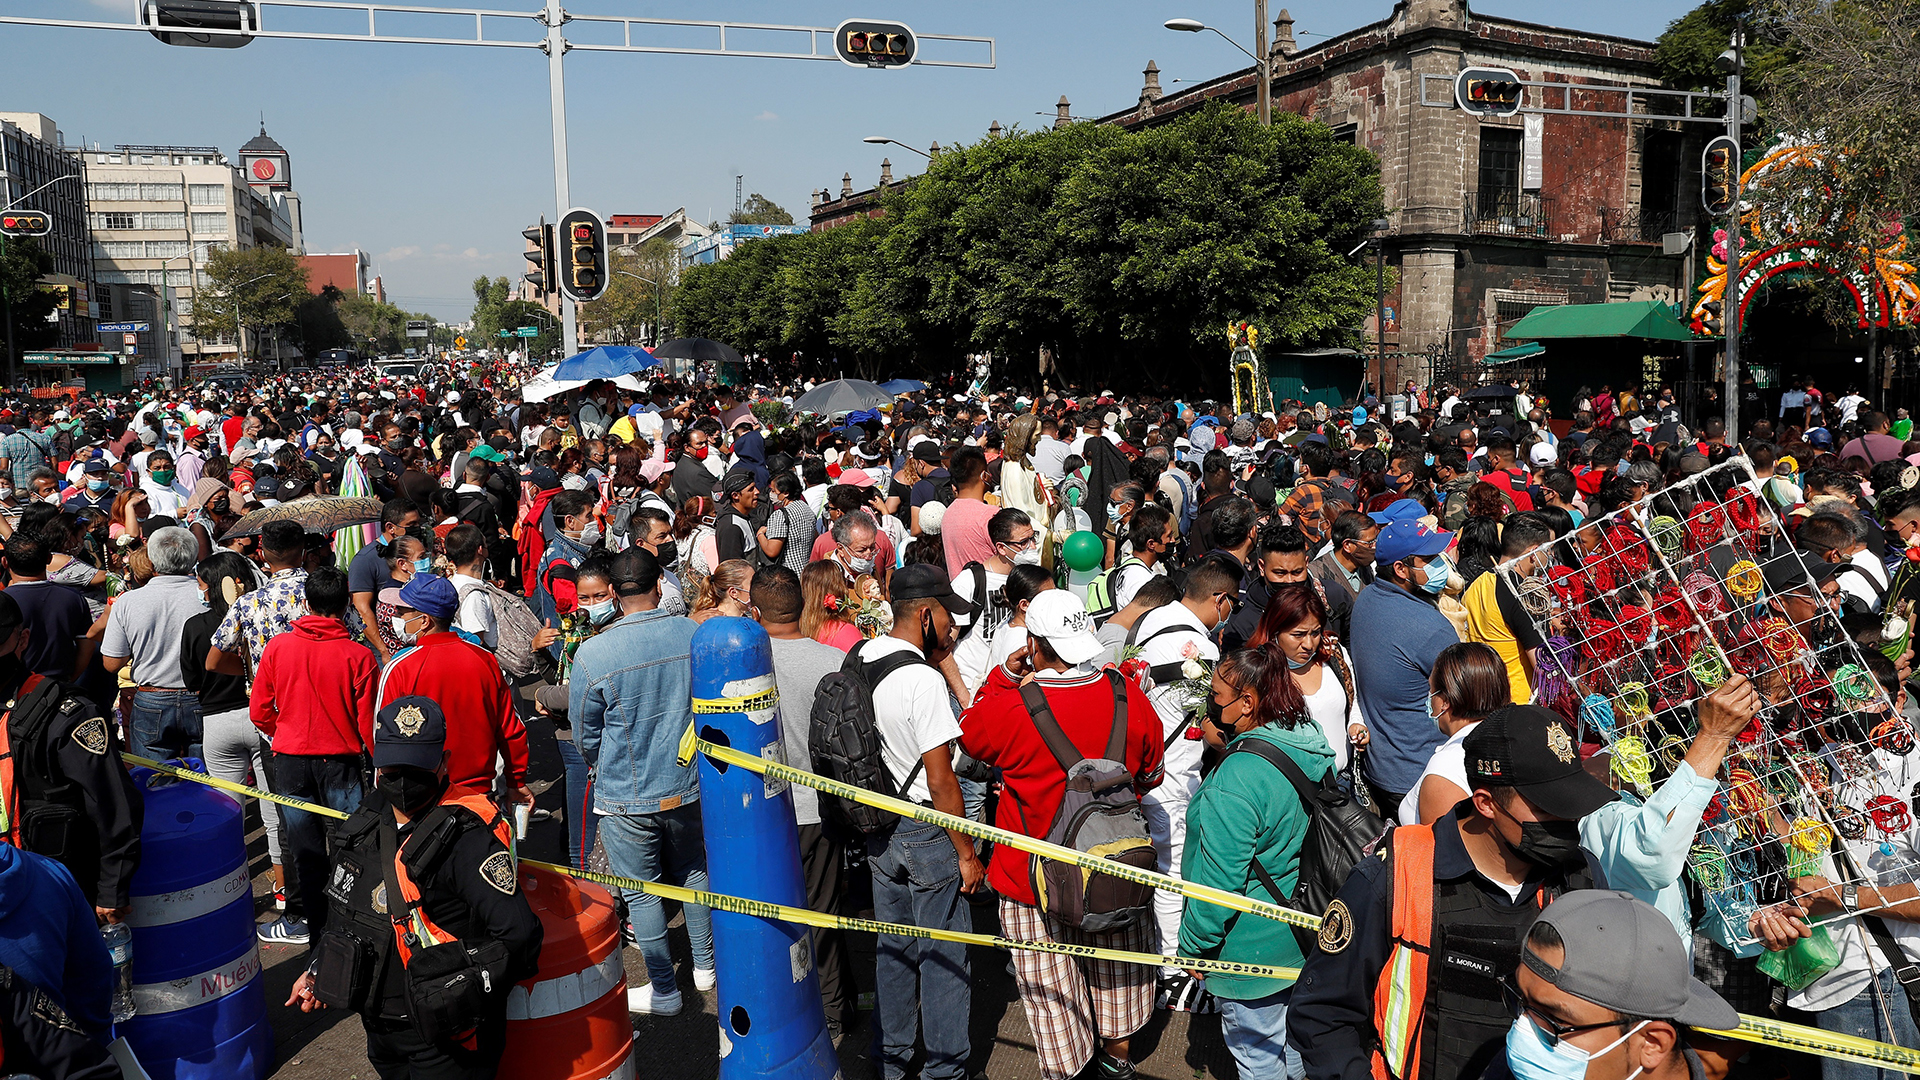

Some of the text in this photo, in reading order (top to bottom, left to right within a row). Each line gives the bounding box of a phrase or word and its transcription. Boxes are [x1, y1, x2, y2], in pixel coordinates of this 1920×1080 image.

[1477, 759, 1501, 772] SSC
[483, 854, 510, 872] POLICIA
[224, 870, 249, 894] CDMX
[1161, 956, 1274, 976] PRECAUCION
[1456, 958, 1482, 970] MORAN
